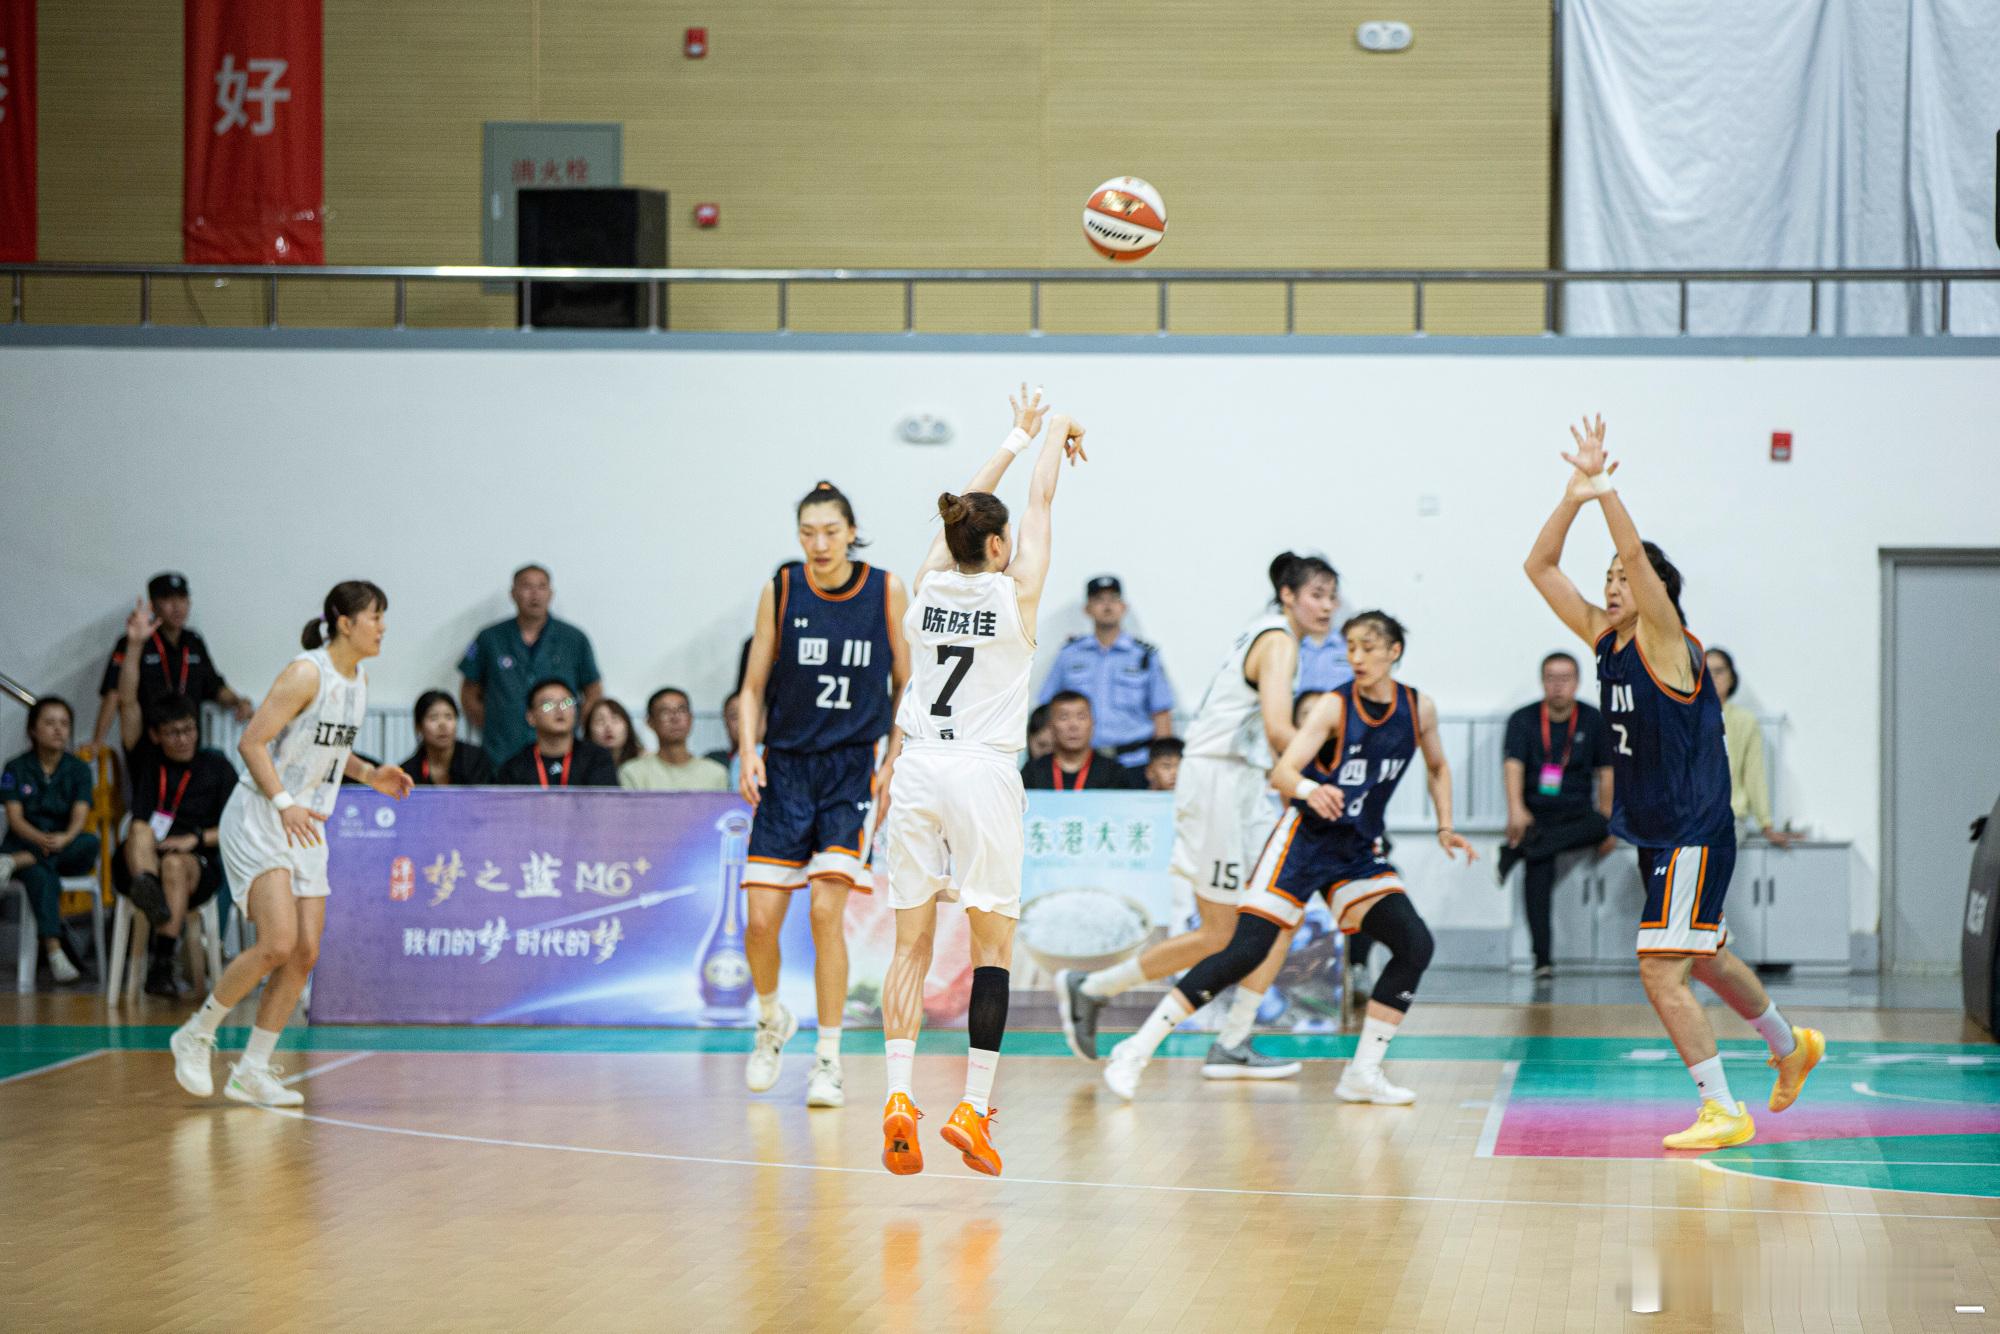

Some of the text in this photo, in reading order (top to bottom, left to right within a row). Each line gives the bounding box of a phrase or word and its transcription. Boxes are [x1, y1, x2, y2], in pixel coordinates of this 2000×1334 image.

[214, 54, 292, 136] 好
[511, 156, 588, 184] 消火栓
[922, 606, 997, 637] 陈晓佳
[797, 637, 872, 668] 四川
[815, 674, 852, 710] 21
[929, 644, 975, 718] 7
[1338, 758, 1407, 787] 四川
[421, 848, 563, 908] 梦之蓝
[1210, 860, 1240, 891] 15
[402, 914, 625, 965] 我们的梦 时代的梦
